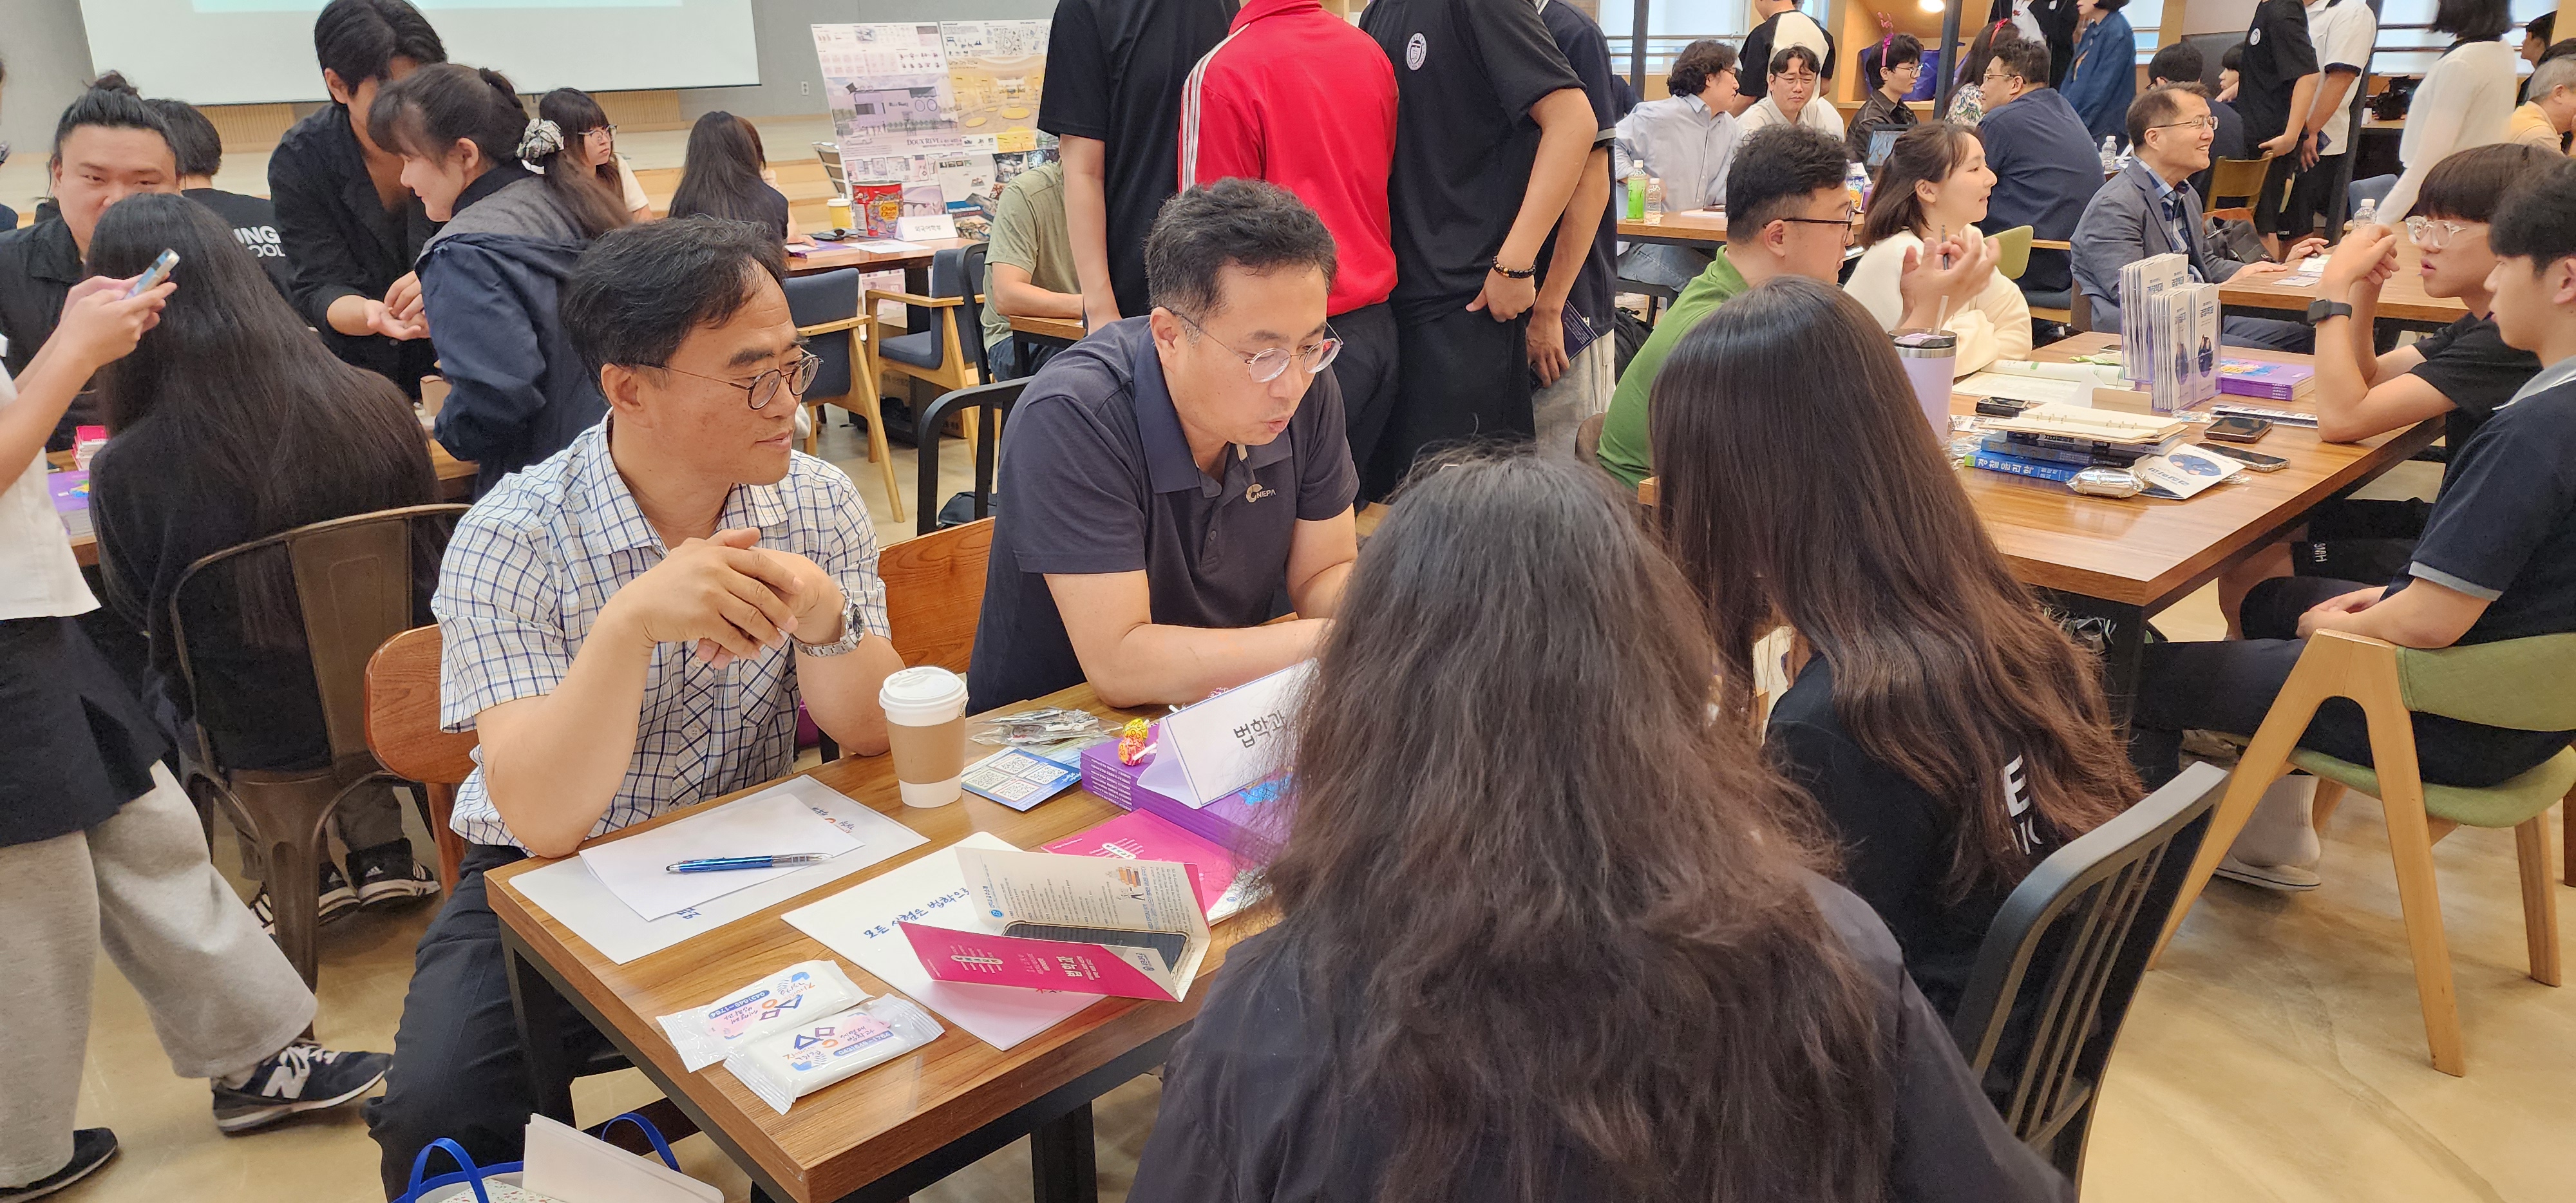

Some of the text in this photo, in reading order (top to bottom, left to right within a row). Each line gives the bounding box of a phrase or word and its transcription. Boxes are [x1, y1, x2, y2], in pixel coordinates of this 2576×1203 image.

[1977, 458, 2034, 475] 경찰윤리학
[1256, 489, 1276, 499] NEPA
[1233, 710, 1286, 748] 법학과
[864, 925, 890, 939] 모든
[1056, 956, 1083, 977] 법학과
